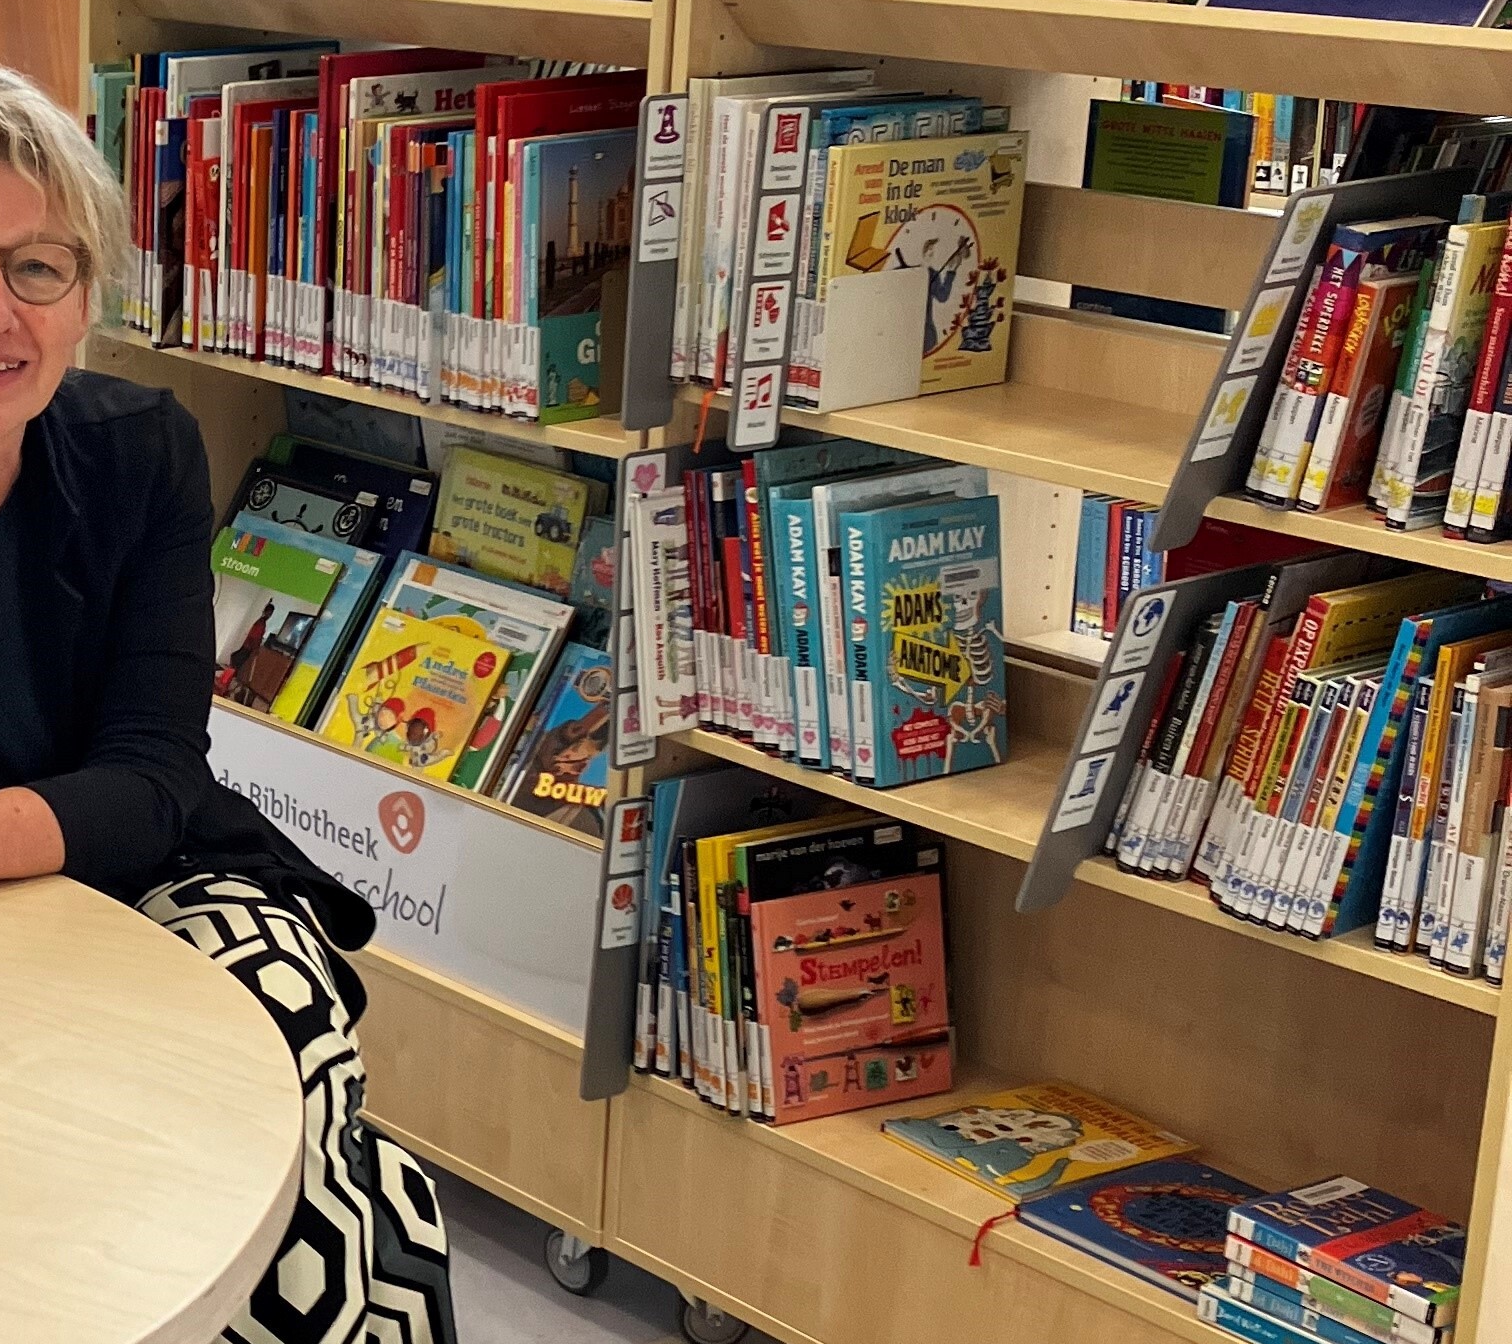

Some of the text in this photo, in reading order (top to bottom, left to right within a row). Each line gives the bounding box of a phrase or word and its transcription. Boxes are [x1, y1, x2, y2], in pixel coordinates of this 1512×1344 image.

[434, 87, 476, 111] Het
[889, 158, 945, 177] De man
[886, 182, 900, 200] in
[904, 179, 923, 199] de
[884, 204, 919, 224] klok
[1308, 266, 1346, 355] HET SUPERDIKKE
[451, 515, 480, 532] grote
[787, 513, 806, 599] ADAM KAY
[888, 531, 944, 562] ADAM
[948, 525, 986, 552] KAY
[220, 557, 260, 577] stroom
[847, 526, 868, 614] ADAM KAY
[894, 591, 942, 627] ADAMS
[1298, 617, 1320, 641] OP
[1250, 668, 1279, 712] HELD
[250, 781, 378, 862] Bibliotheek
[353, 868, 446, 935] school
